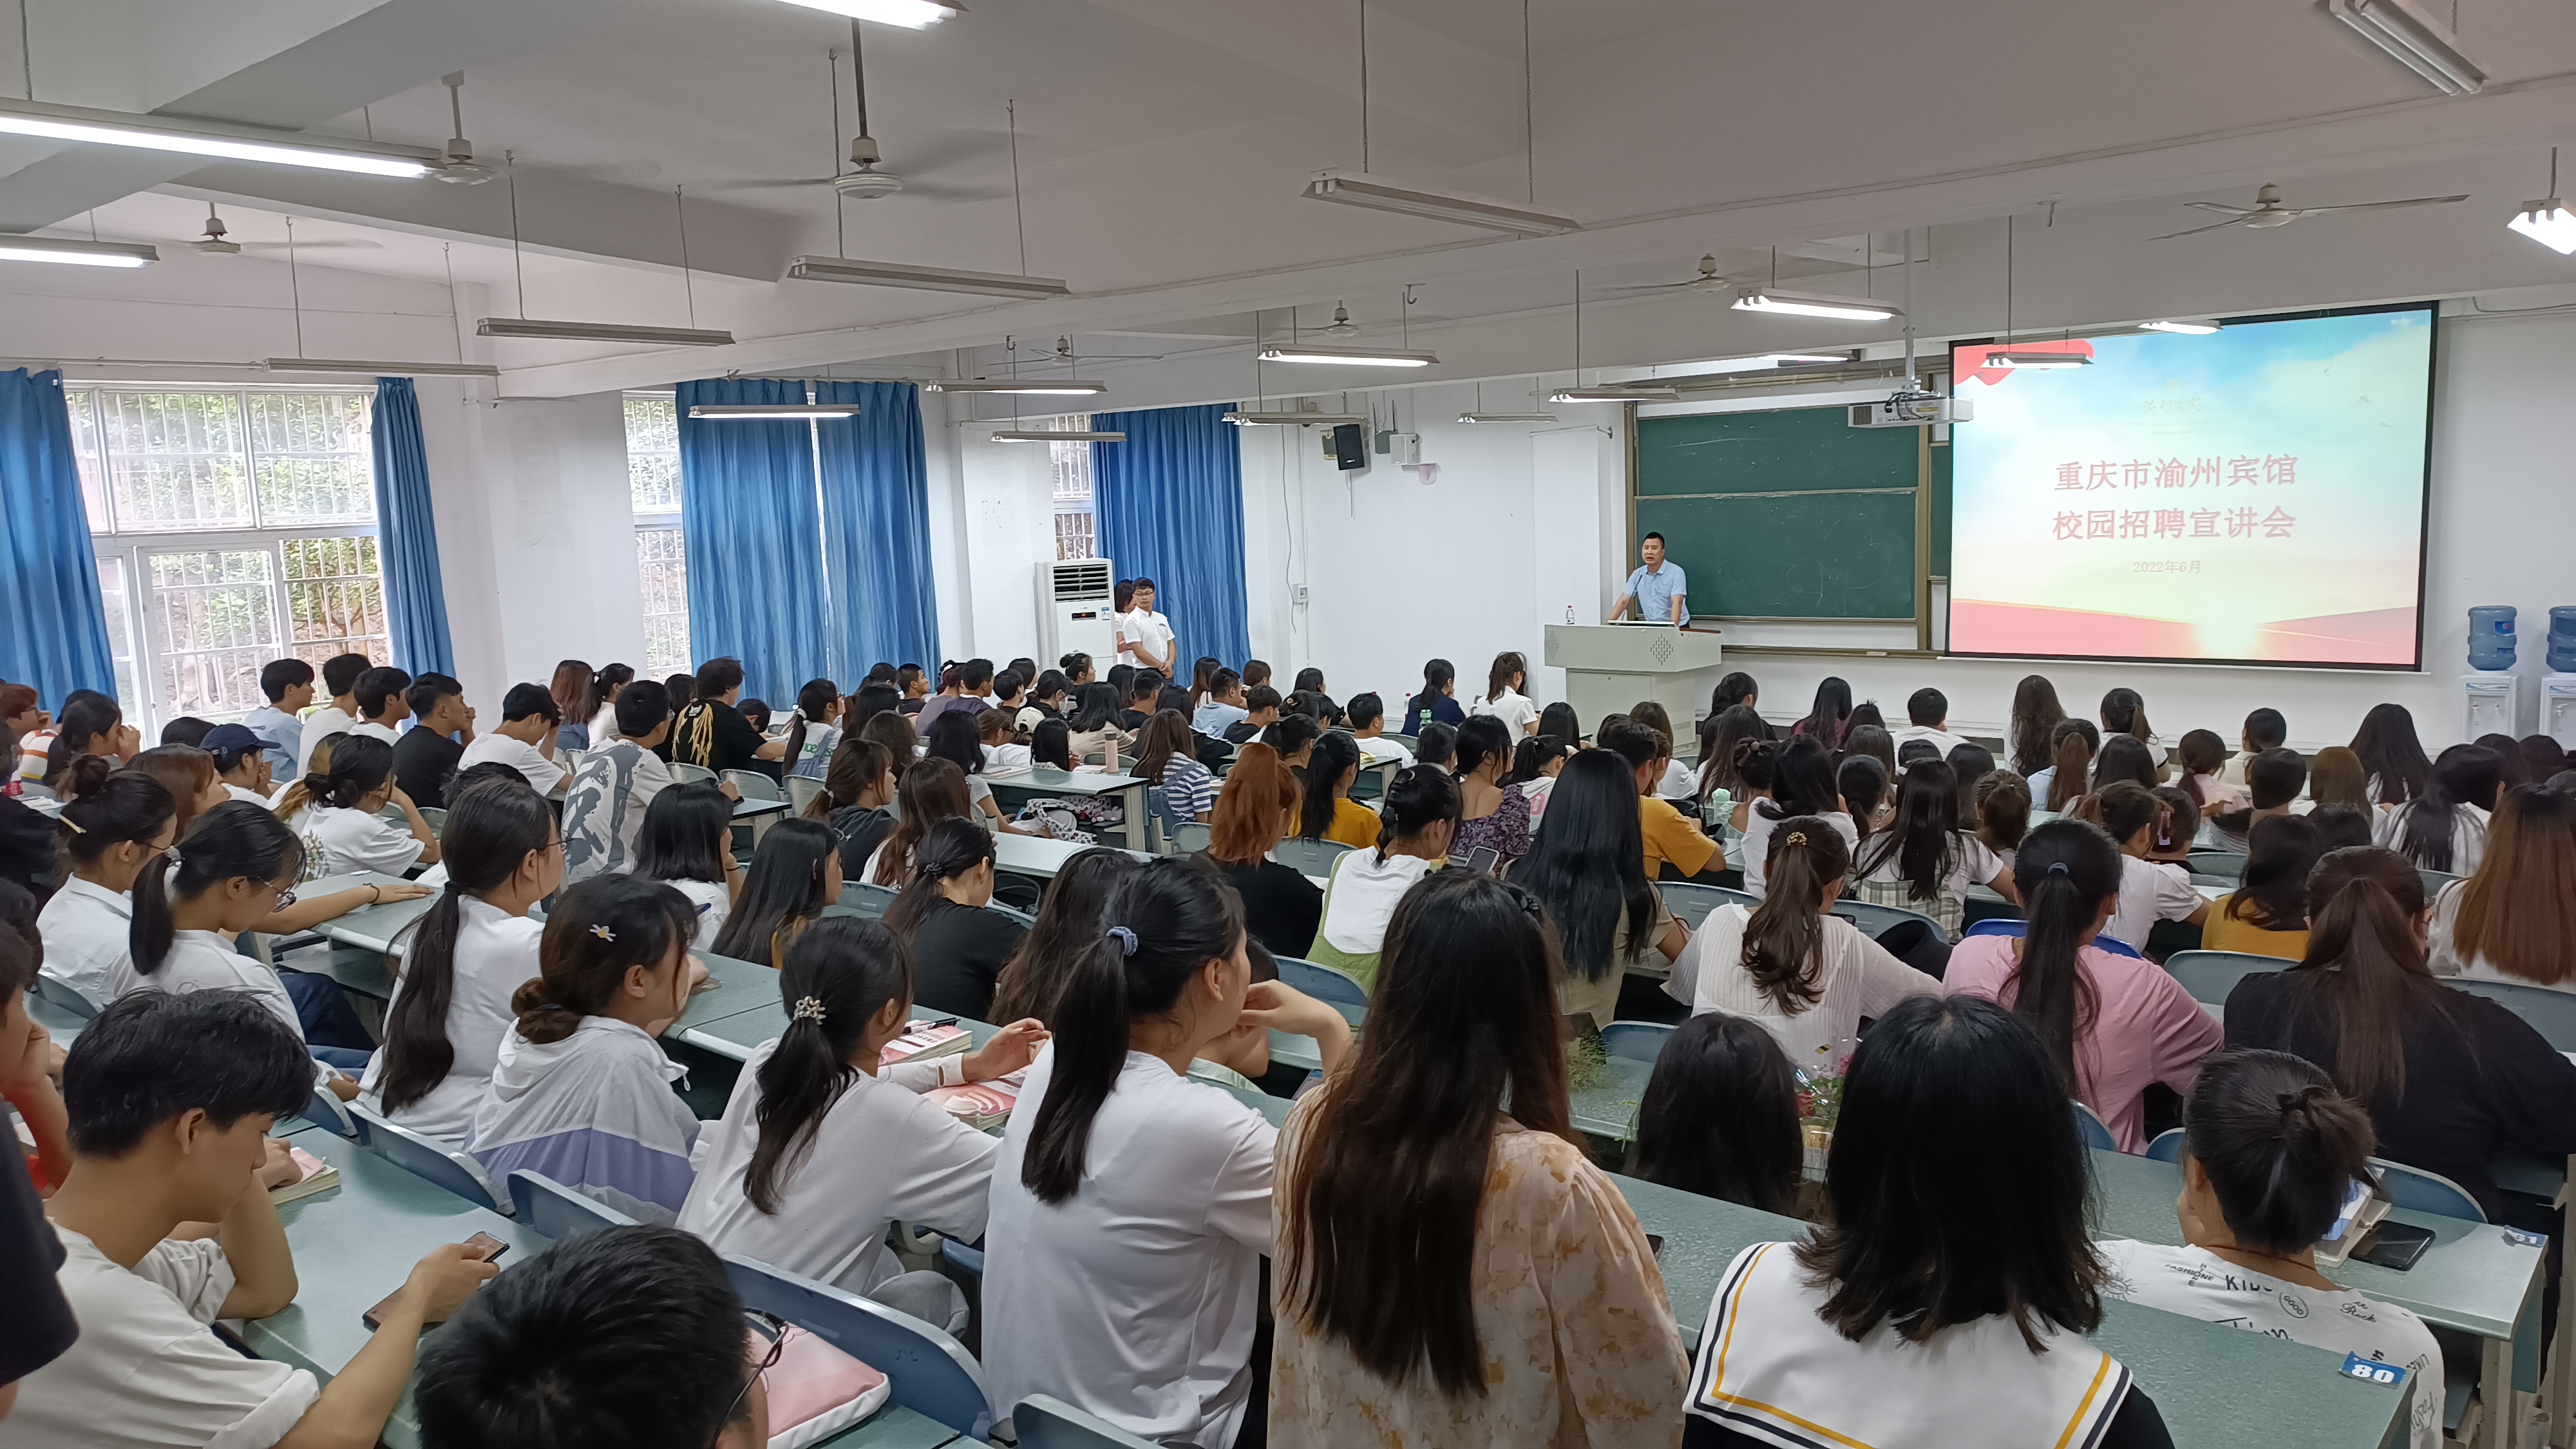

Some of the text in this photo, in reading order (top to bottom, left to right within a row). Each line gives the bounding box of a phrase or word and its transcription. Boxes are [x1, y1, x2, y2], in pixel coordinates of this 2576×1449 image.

[2054, 453, 2298, 491] 重庆市渝州宾馆
[2052, 506, 2296, 540] 校园招聘宣讲会
[2133, 560, 2201, 574] 2022年6月
[2225, 1274, 2273, 1292] KI
[2284, 1295, 2304, 1315] GOOD
[2351, 1364, 2395, 1383] 80
